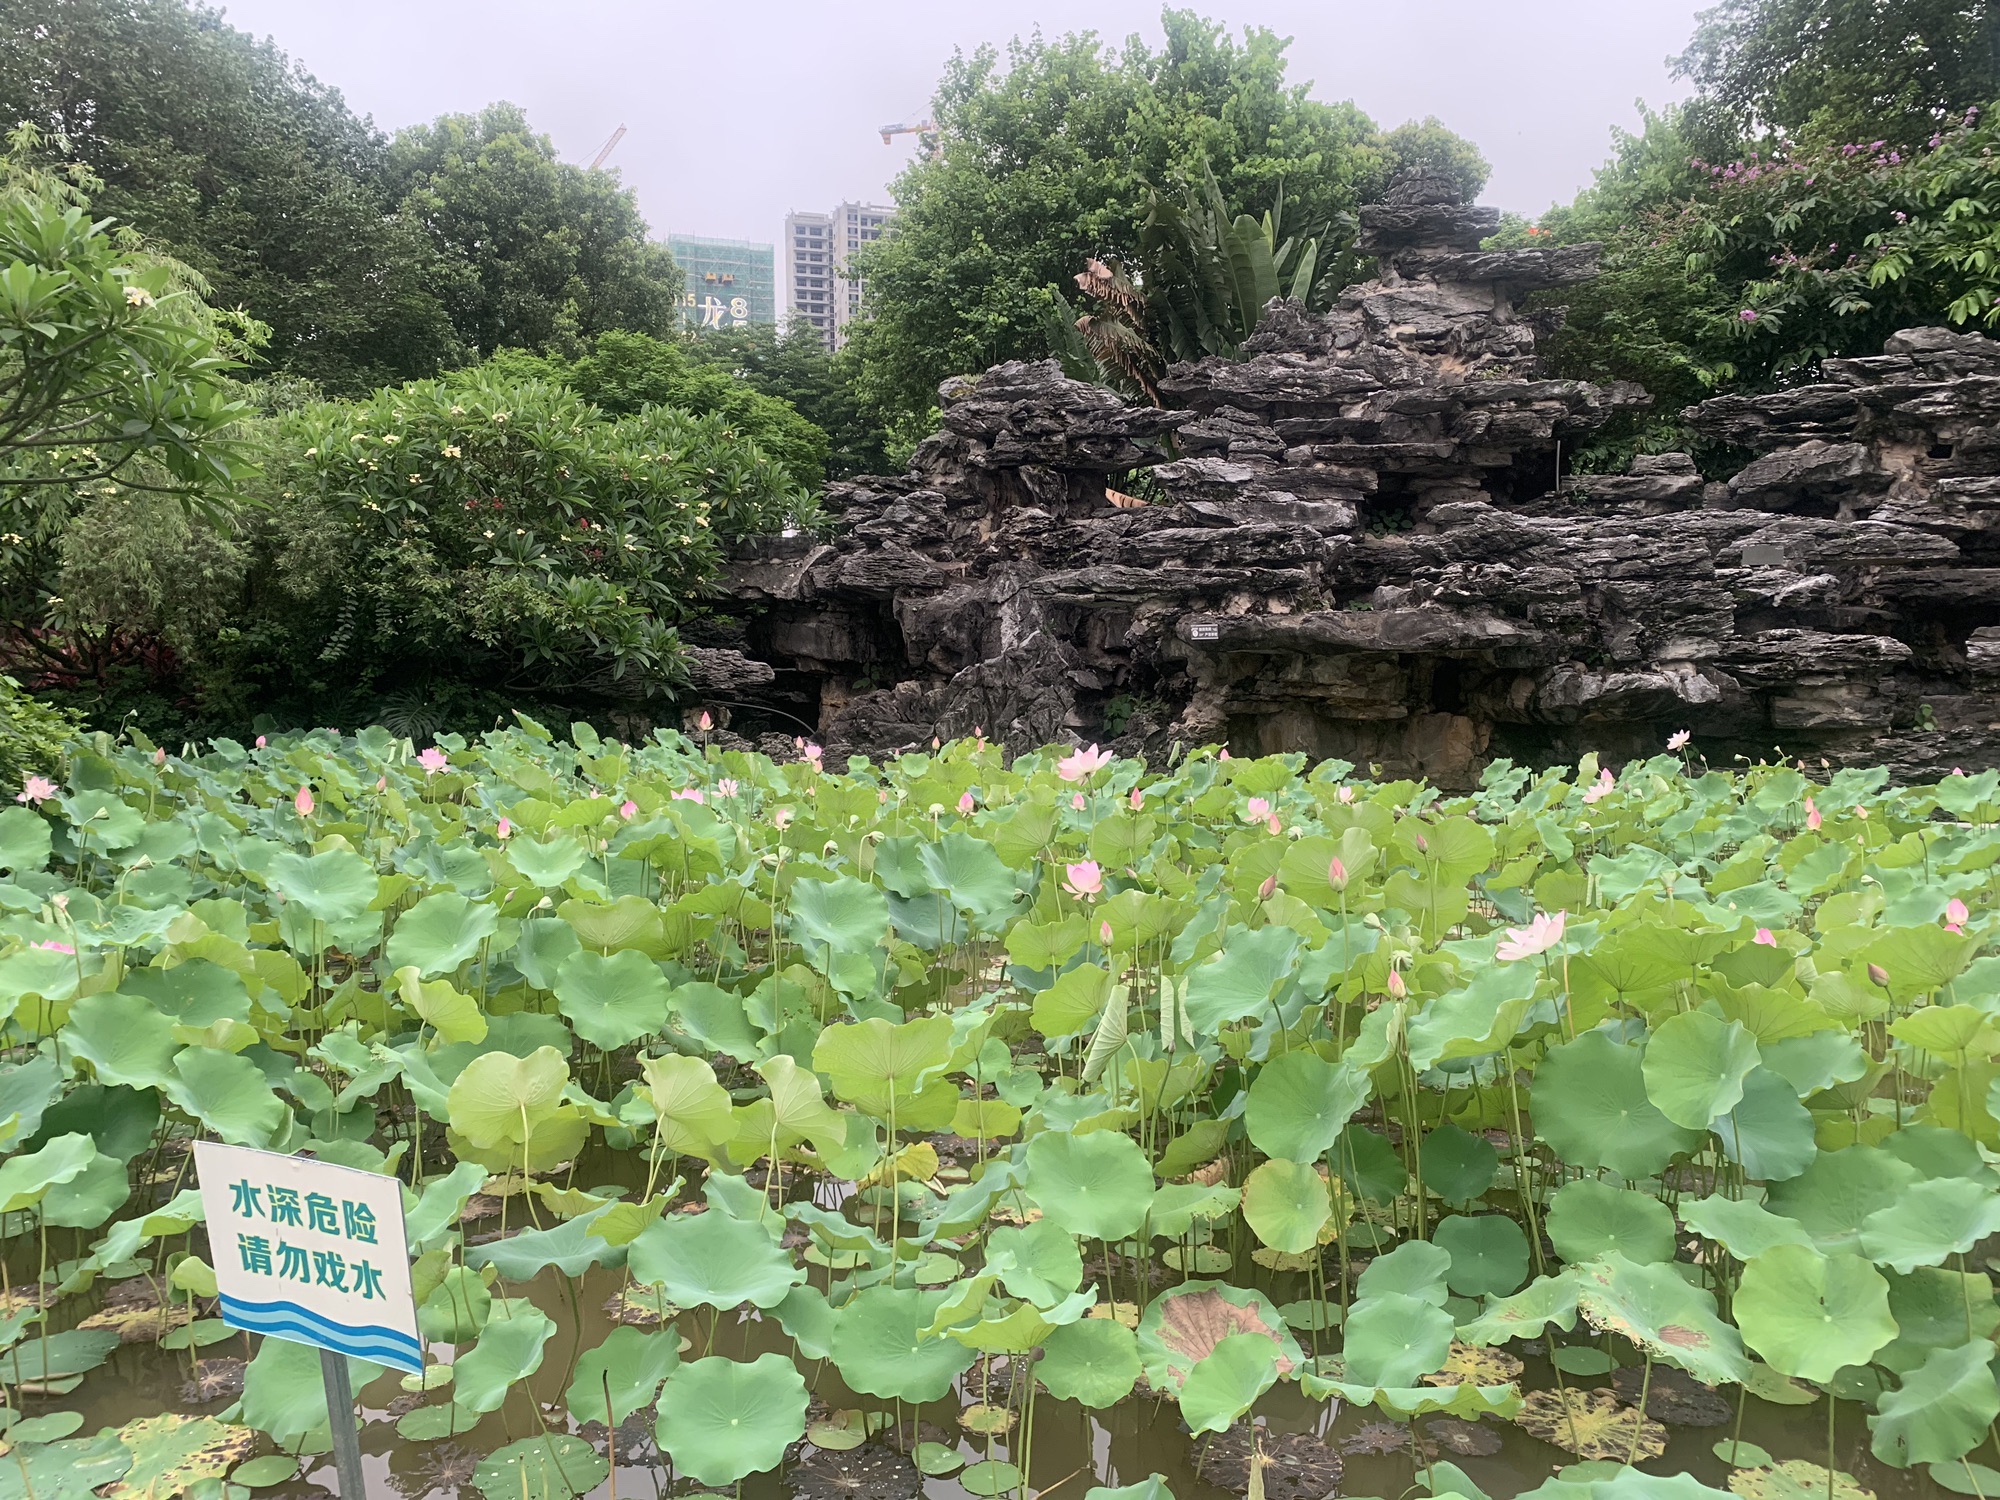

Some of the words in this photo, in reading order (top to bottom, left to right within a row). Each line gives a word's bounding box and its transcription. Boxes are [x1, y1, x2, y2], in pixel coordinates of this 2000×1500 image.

[228, 1178, 379, 1245] 水深危险
[237, 1233, 387, 1301] 请勿戏水
